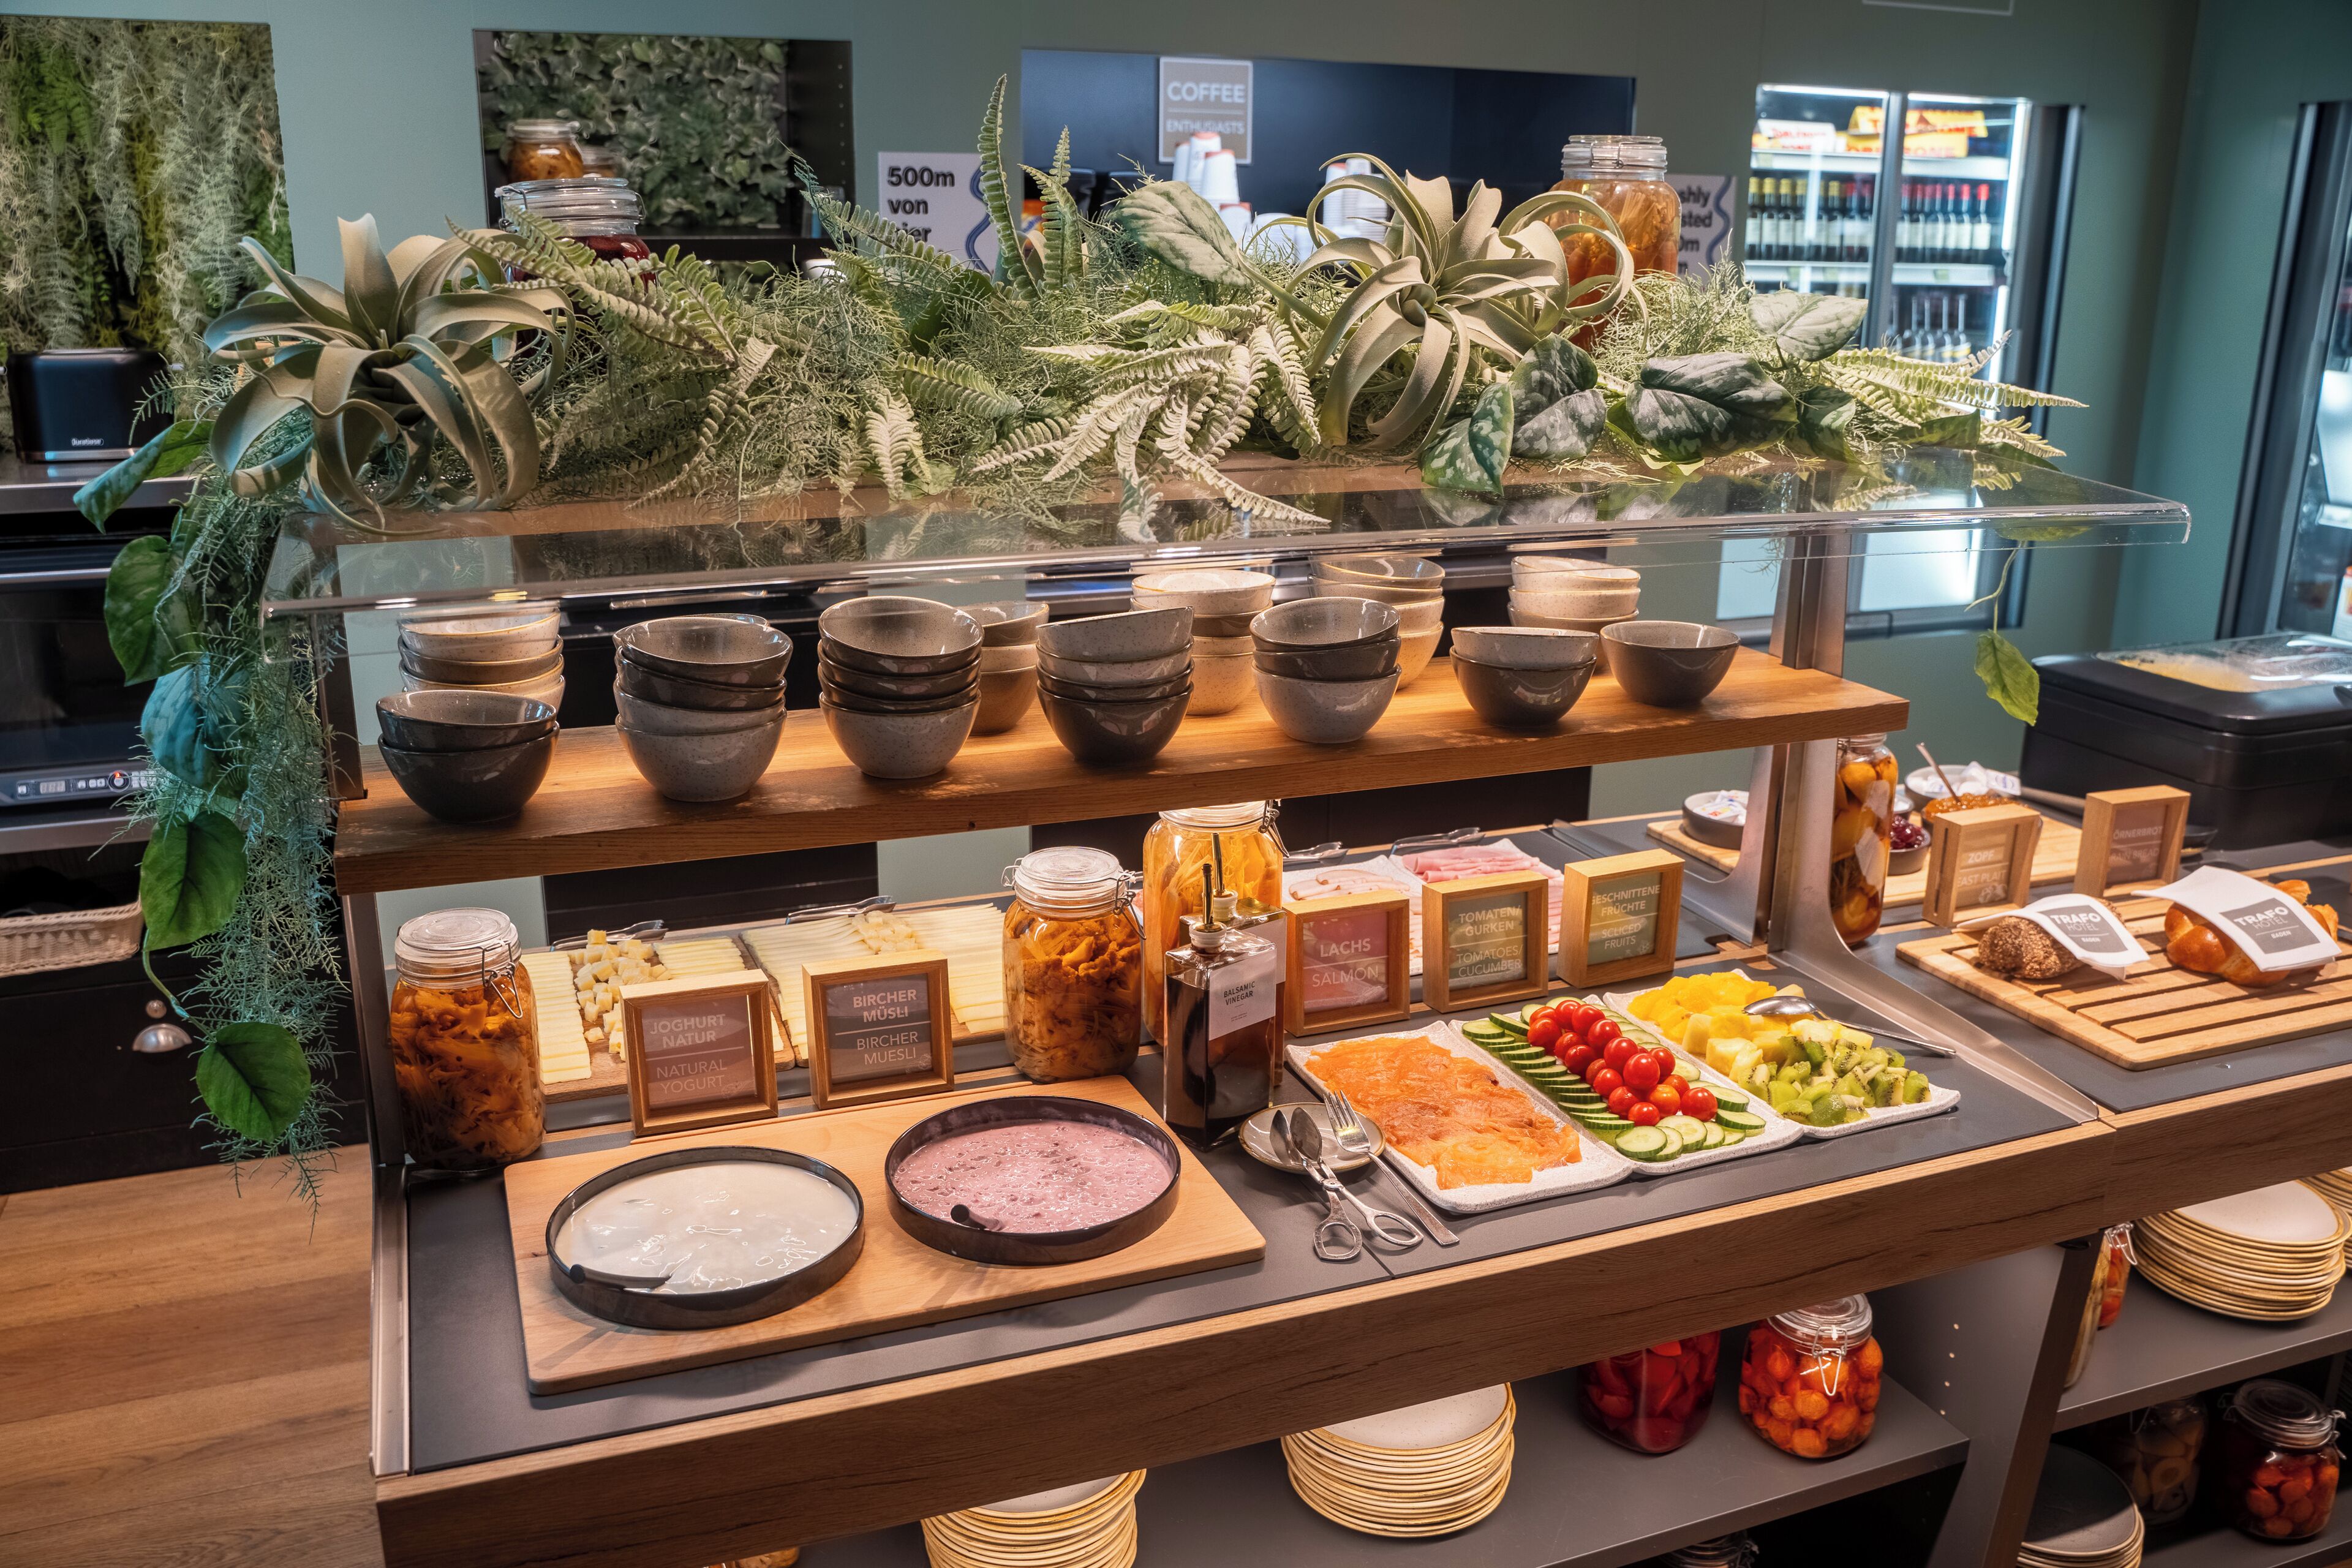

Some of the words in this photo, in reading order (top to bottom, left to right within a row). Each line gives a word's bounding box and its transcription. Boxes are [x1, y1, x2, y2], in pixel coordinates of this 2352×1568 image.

[1167, 81, 1246, 104] COFFEE
[1166, 119, 1245, 135] ENTHUSIASTS
[888, 165, 955, 187] 500m
[888, 198, 929, 214] von
[1678, 186, 1711, 209] shly
[1681, 210, 1713, 228] sted
[2113, 826, 2163, 840] ÖRNERBROT
[1968, 849, 1995, 864] ZOPF
[1957, 873, 1979, 888] EAST
[1592, 885, 1660, 905] GESCHNITTENE
[1458, 905, 1521, 924] TOMATEN/
[1602, 900, 1646, 916] FRÜCHTE
[2233, 906, 2289, 926] TRAFO
[2050, 913, 2101, 924] TRAFO
[2066, 922, 2099, 932] HOTEL
[2252, 916, 2288, 930] HOTEL
[1465, 920, 1514, 936] GURKEN
[1602, 923, 1642, 938] SCLICED
[2271, 930, 2292, 939] BADEN
[1320, 938, 1371, 957] LACHS
[1605, 936, 1636, 949] FRUITS
[1457, 944, 1523, 963] TOMATOES/
[1312, 965, 1378, 987] SALMON
[1458, 959, 1523, 977] CUCUMBER
[853, 989, 917, 1008] BIRCHER
[1224, 981, 1255, 998] BALSAMIC
[1226, 990, 1253, 1006] VINEGAR
[863, 1006, 909, 1022] MÜSLI
[650, 1014, 726, 1035] JOGHURT
[662, 1030, 717, 1048] NATUR
[857, 1031, 918, 1050] BIRCHER
[864, 1047, 916, 1065] MUESLI
[657, 1059, 728, 1079] NATURAL
[660, 1075, 725, 1094] YOGURT
